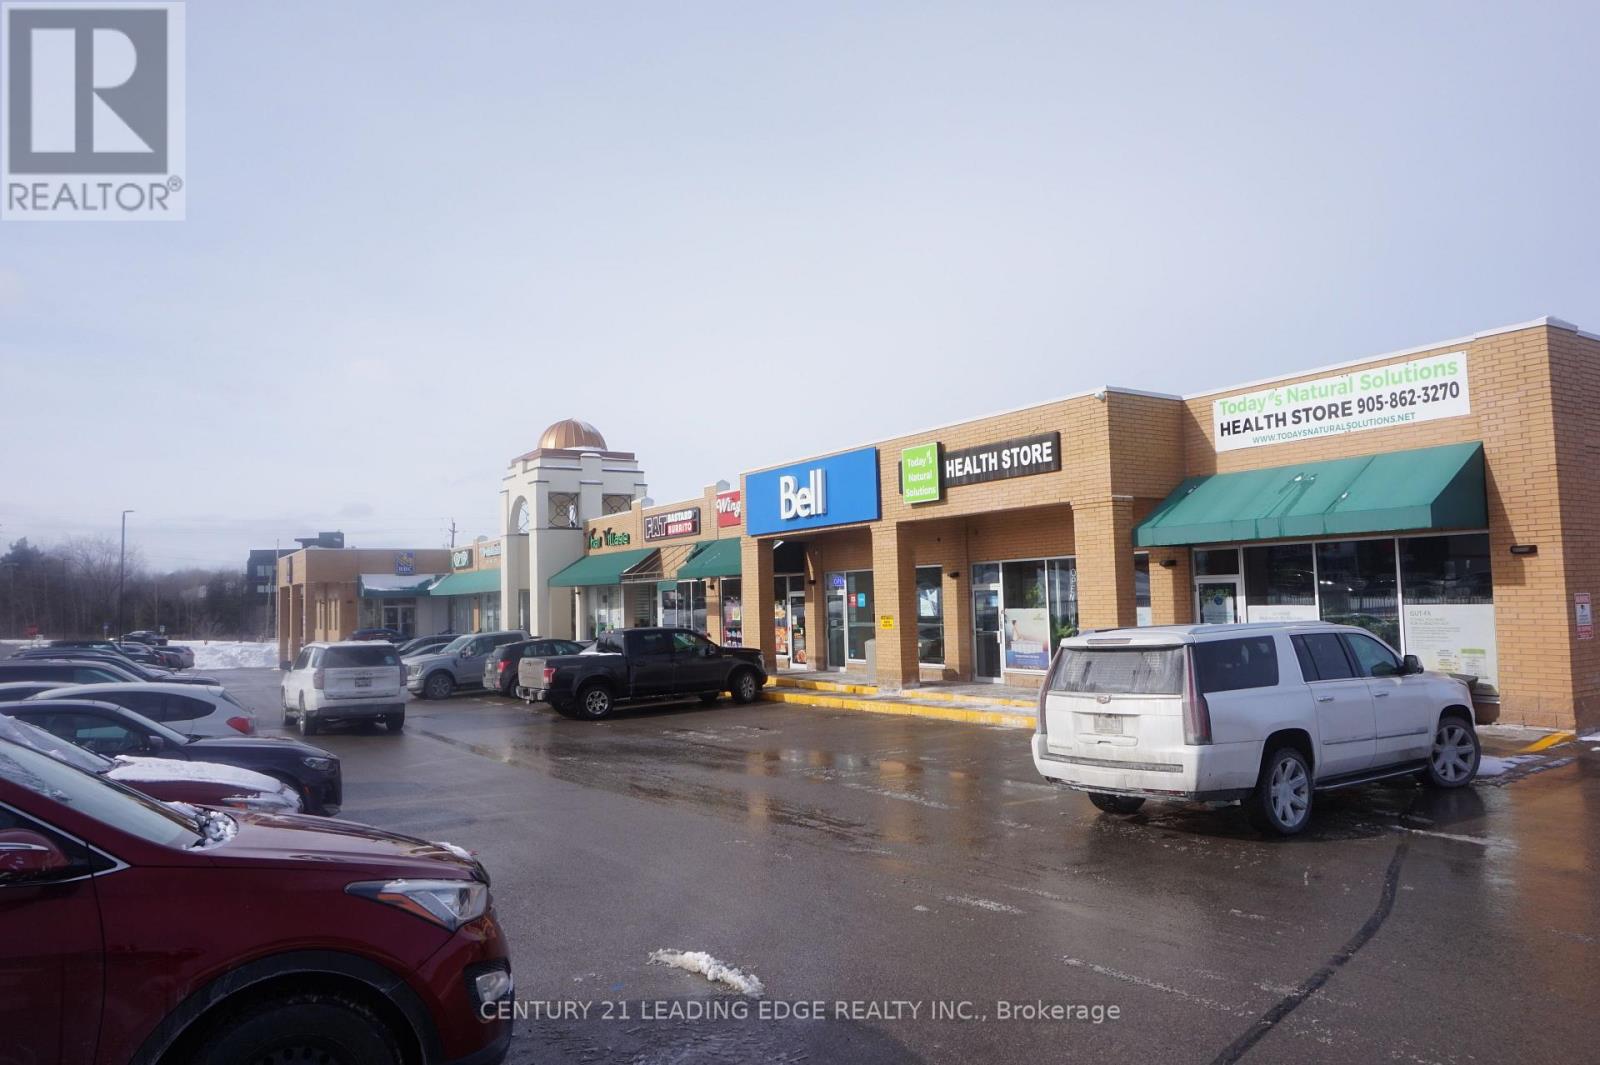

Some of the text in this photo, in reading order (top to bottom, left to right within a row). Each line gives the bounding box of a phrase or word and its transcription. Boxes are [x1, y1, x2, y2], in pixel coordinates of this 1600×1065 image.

[1286, 375, 1354, 405] Natural
[1360, 360, 1459, 392] Solutions
[1220, 381, 1460, 437] HEALTH STORE 905-862-3270
[1252, 412, 1416, 445] WWW.TODAYSNATURALSOLUTIONS.NET
[945, 441, 1052, 478] HEALTH STORE
[907, 470, 933, 482] Natural
[780, 468, 824, 520] Bell
[905, 485, 937, 498] Solutions
[645, 515, 667, 539] FAT
[667, 510, 693, 523] BASTARD
[667, 522, 693, 535] BURRITO
